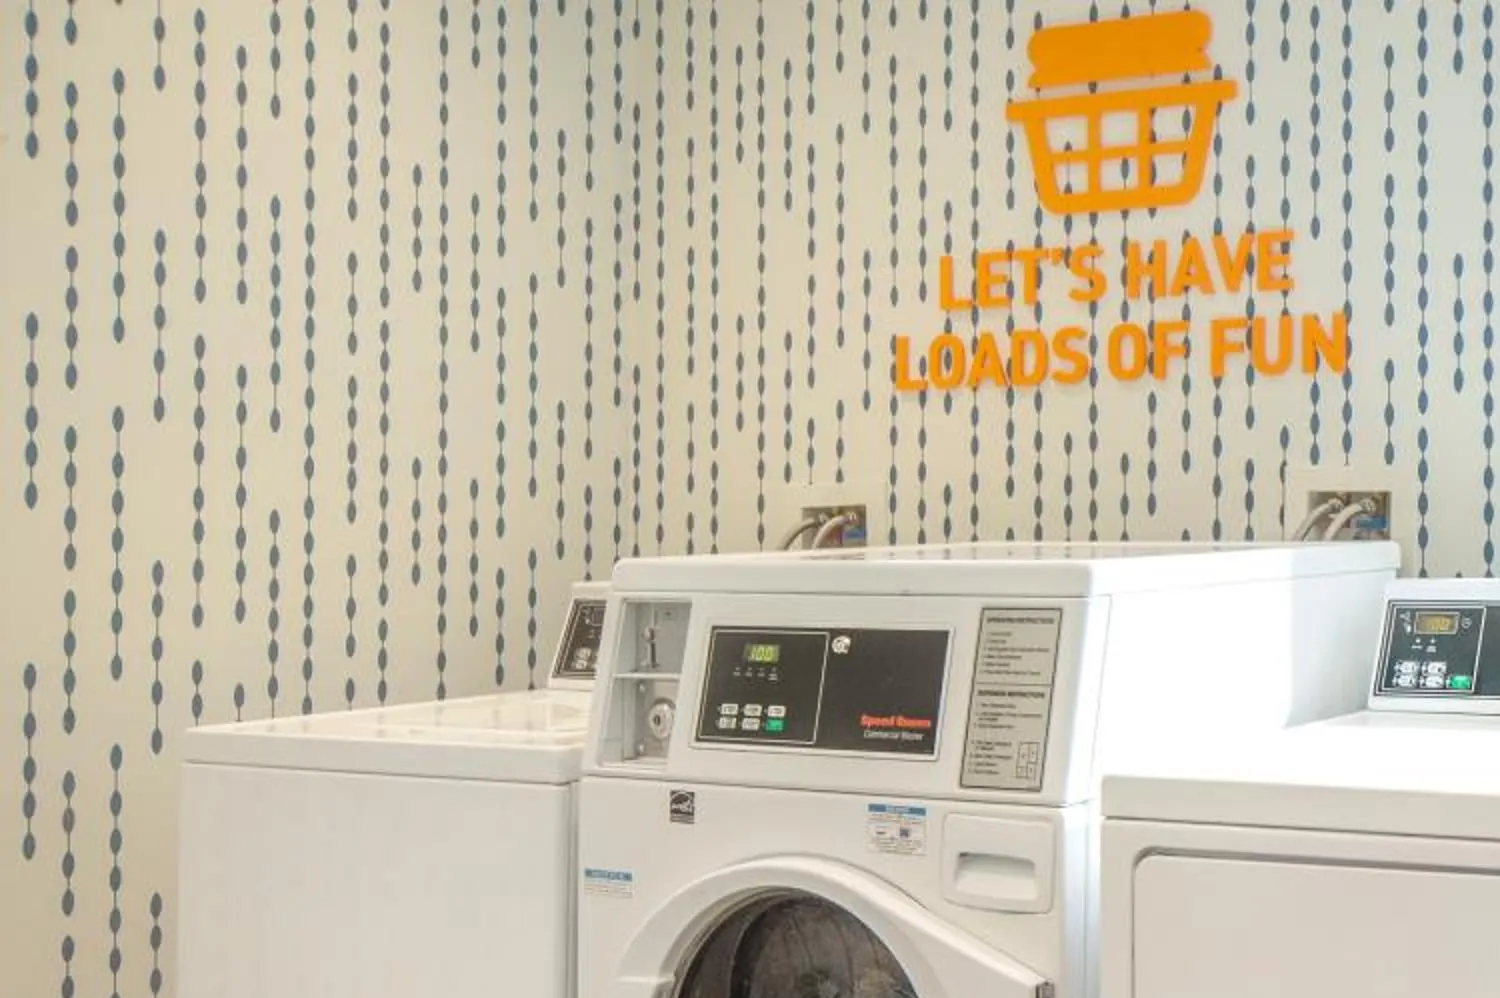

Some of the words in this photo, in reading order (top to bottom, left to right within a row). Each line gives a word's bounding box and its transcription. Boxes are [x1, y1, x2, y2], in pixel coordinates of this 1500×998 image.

[939, 245, 1107, 311] LET'S
[1125, 230, 1294, 299] HAVE
[894, 326, 1089, 391] LOADS
[1107, 319, 1190, 381] OF
[1210, 310, 1348, 378] FUN
[861, 714, 895, 729] Speed
